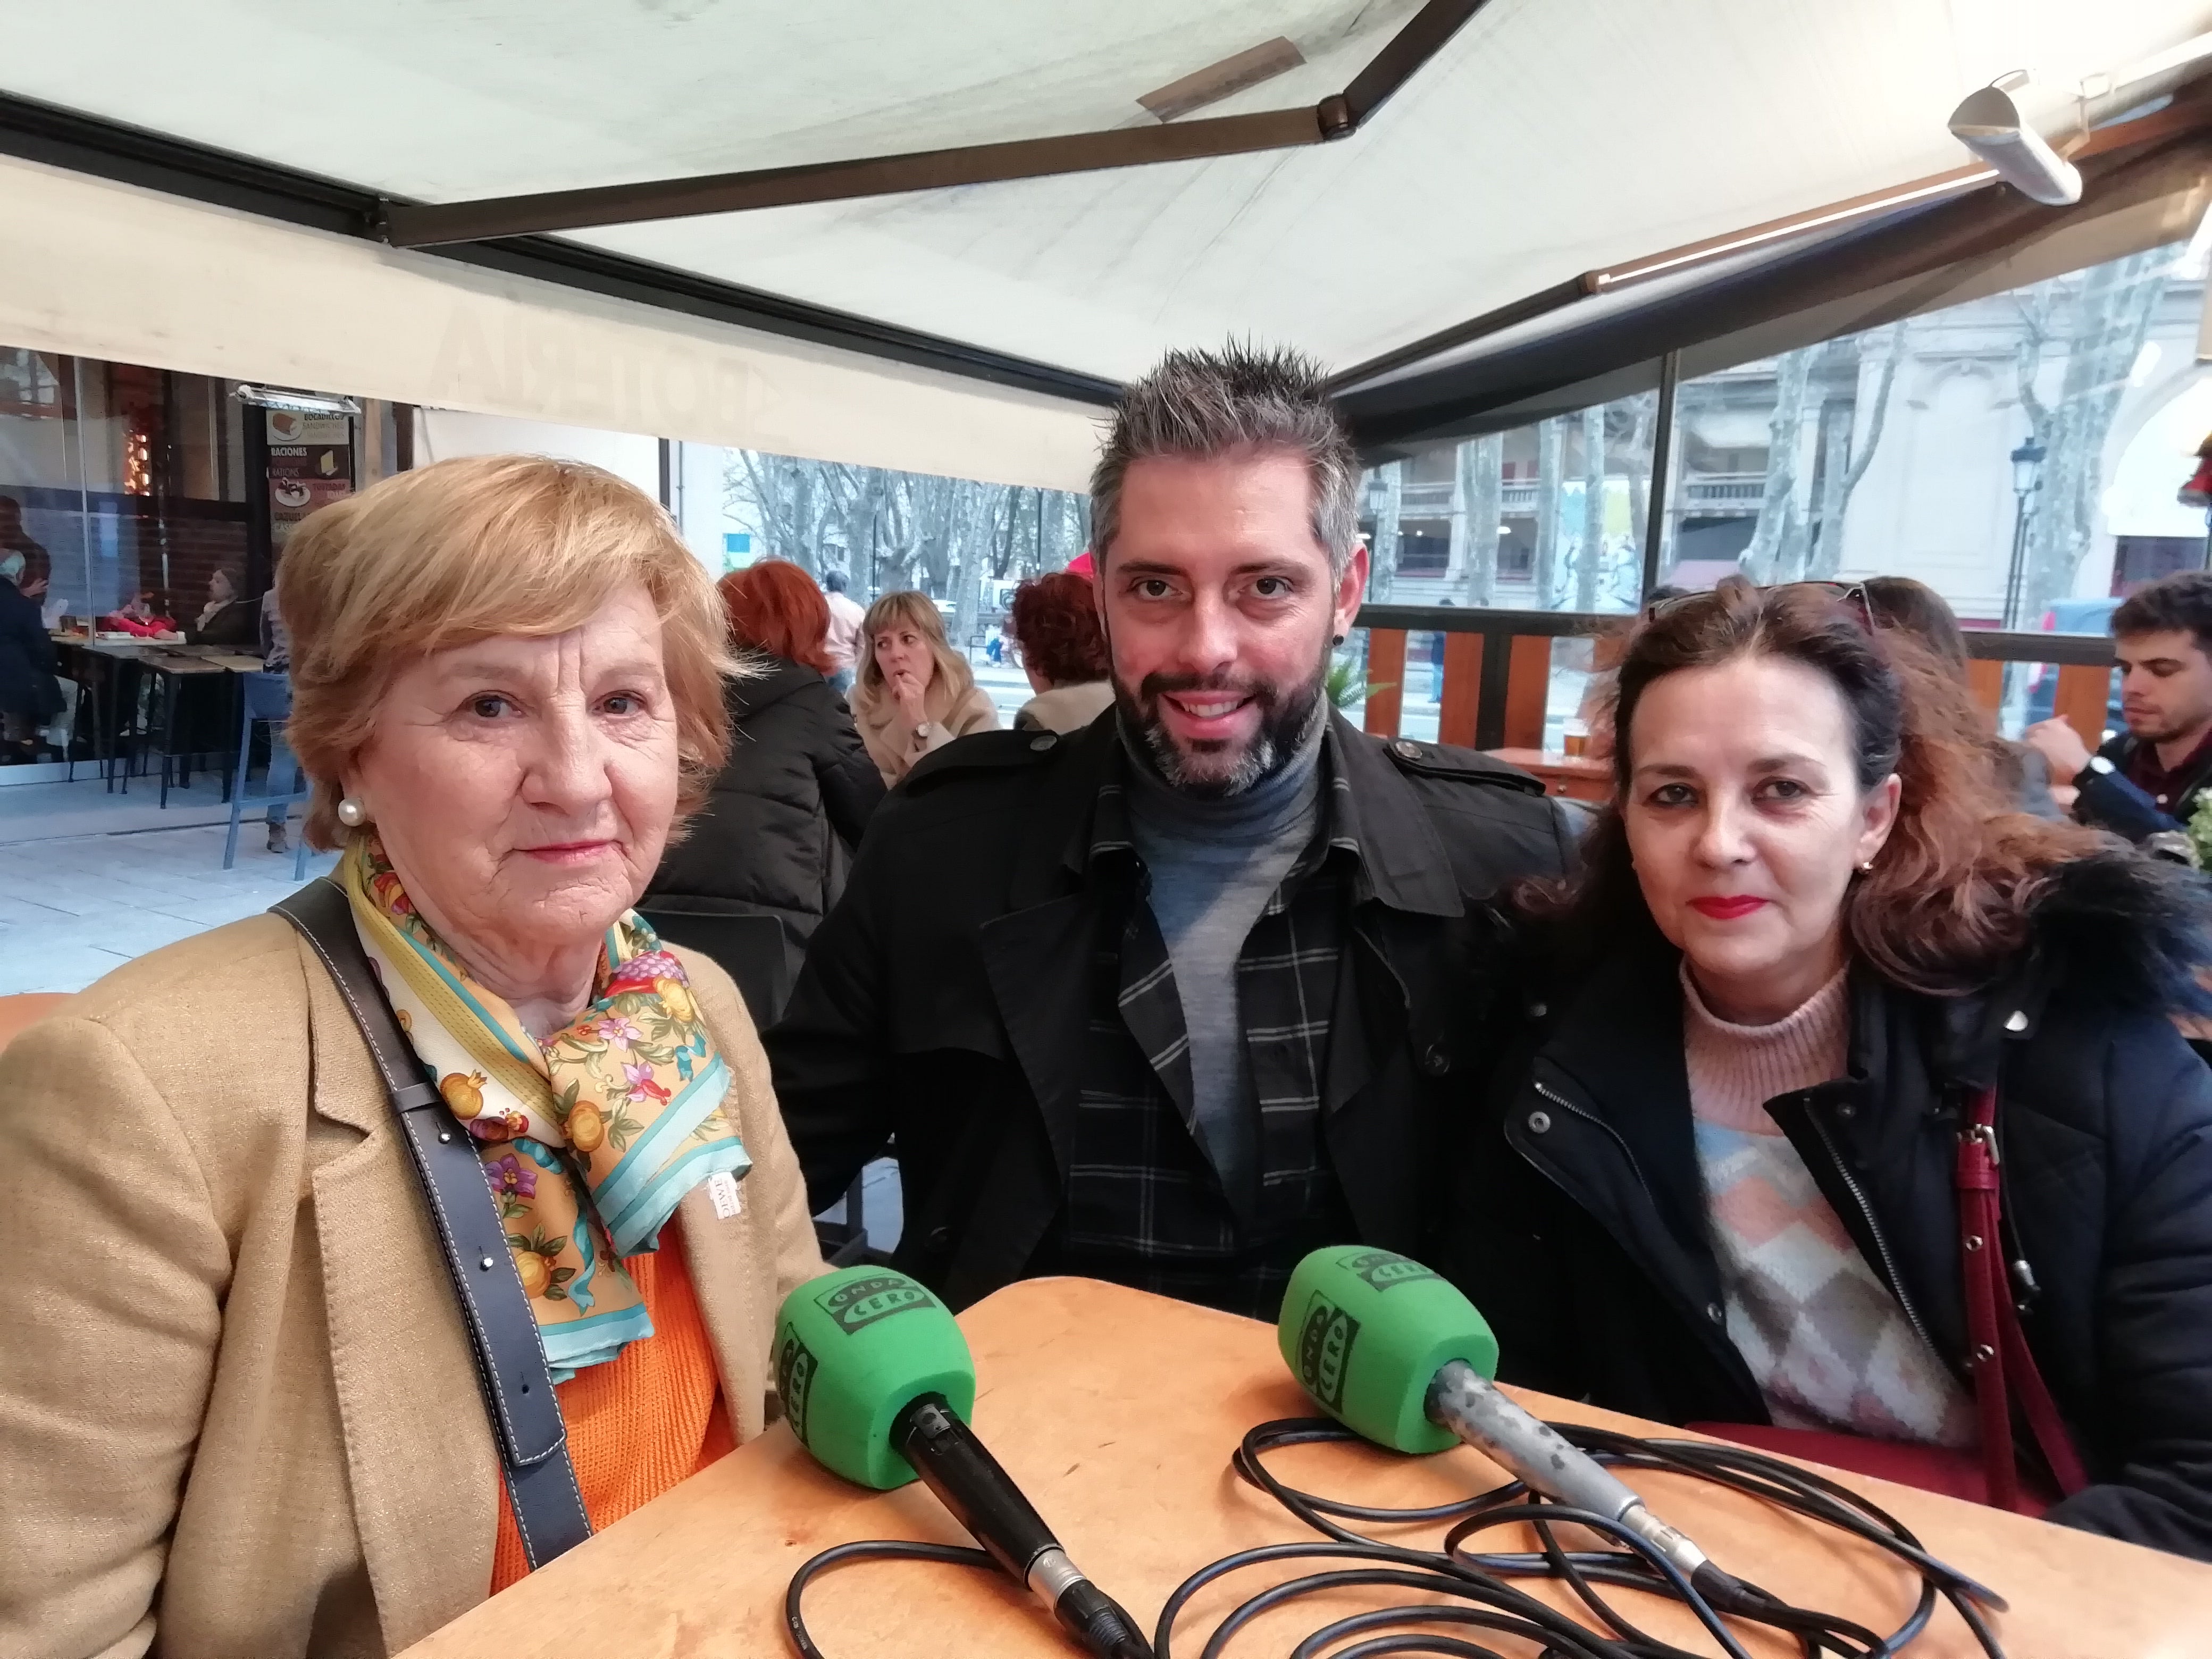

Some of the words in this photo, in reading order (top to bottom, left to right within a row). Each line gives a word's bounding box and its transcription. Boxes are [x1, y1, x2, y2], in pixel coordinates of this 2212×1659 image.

[271, 447, 307, 456] RACIONES
[834, 1279, 900, 1302] ONDA
[854, 1291, 915, 1316] CERO
[1303, 1314, 1324, 1378] ONDA
[1321, 1325, 1343, 1390] CERO
